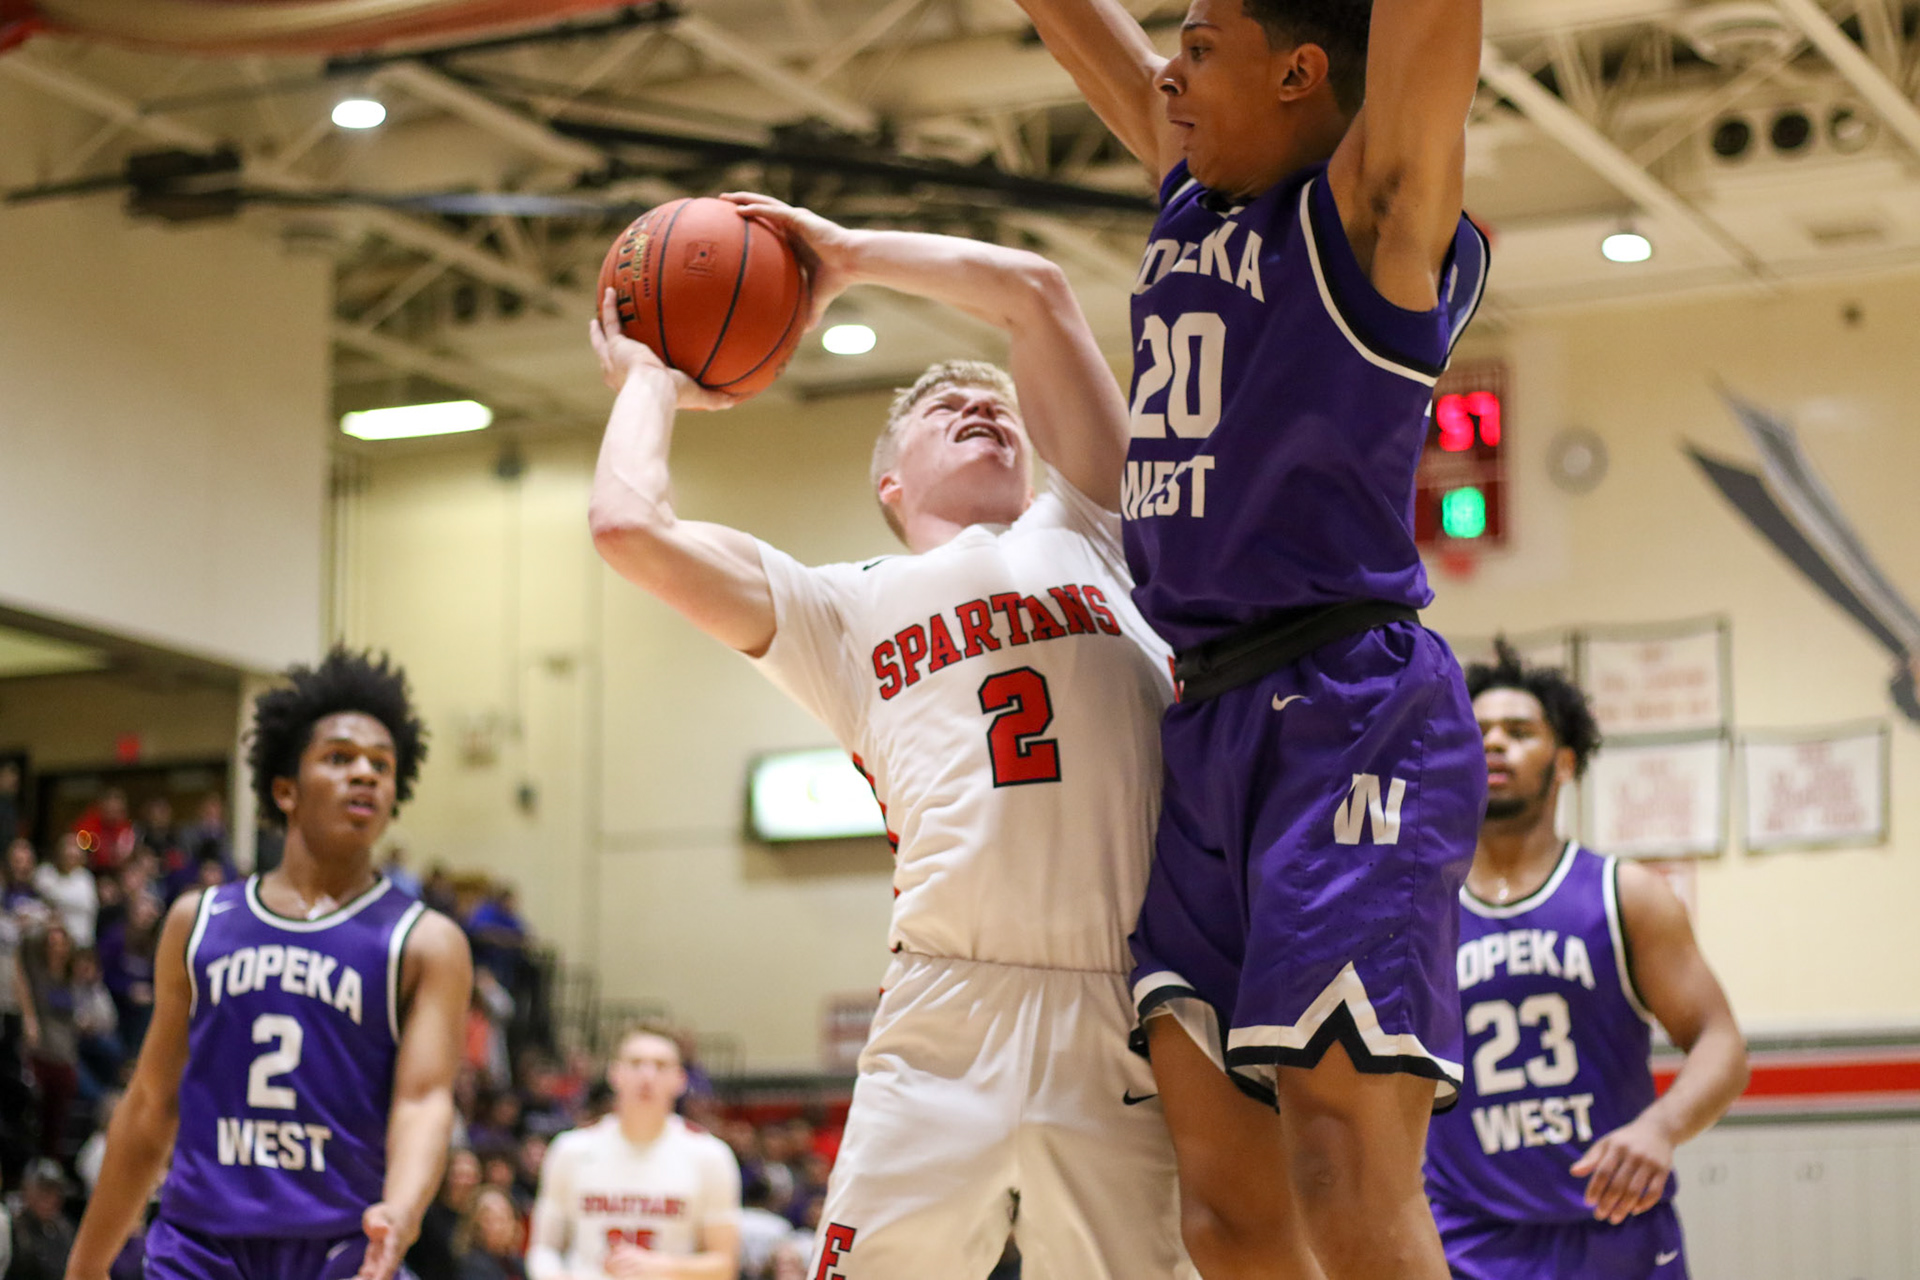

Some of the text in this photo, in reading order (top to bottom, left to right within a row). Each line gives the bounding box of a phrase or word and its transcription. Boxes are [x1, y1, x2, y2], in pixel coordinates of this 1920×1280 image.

[1130, 311, 1227, 440] 20
[1121, 455, 1216, 521] WEST
[871, 583, 1123, 701] SPARTANS
[977, 665, 1062, 788] 2
[1333, 772, 1407, 845] W
[205, 943, 363, 1027] TOPEKA
[1456, 929, 1597, 991] OPEKA
[246, 1012, 304, 1110] 2
[1465, 991, 1580, 1097] 23
[216, 1116, 333, 1174] WEST
[1470, 1091, 1595, 1156] WEST
